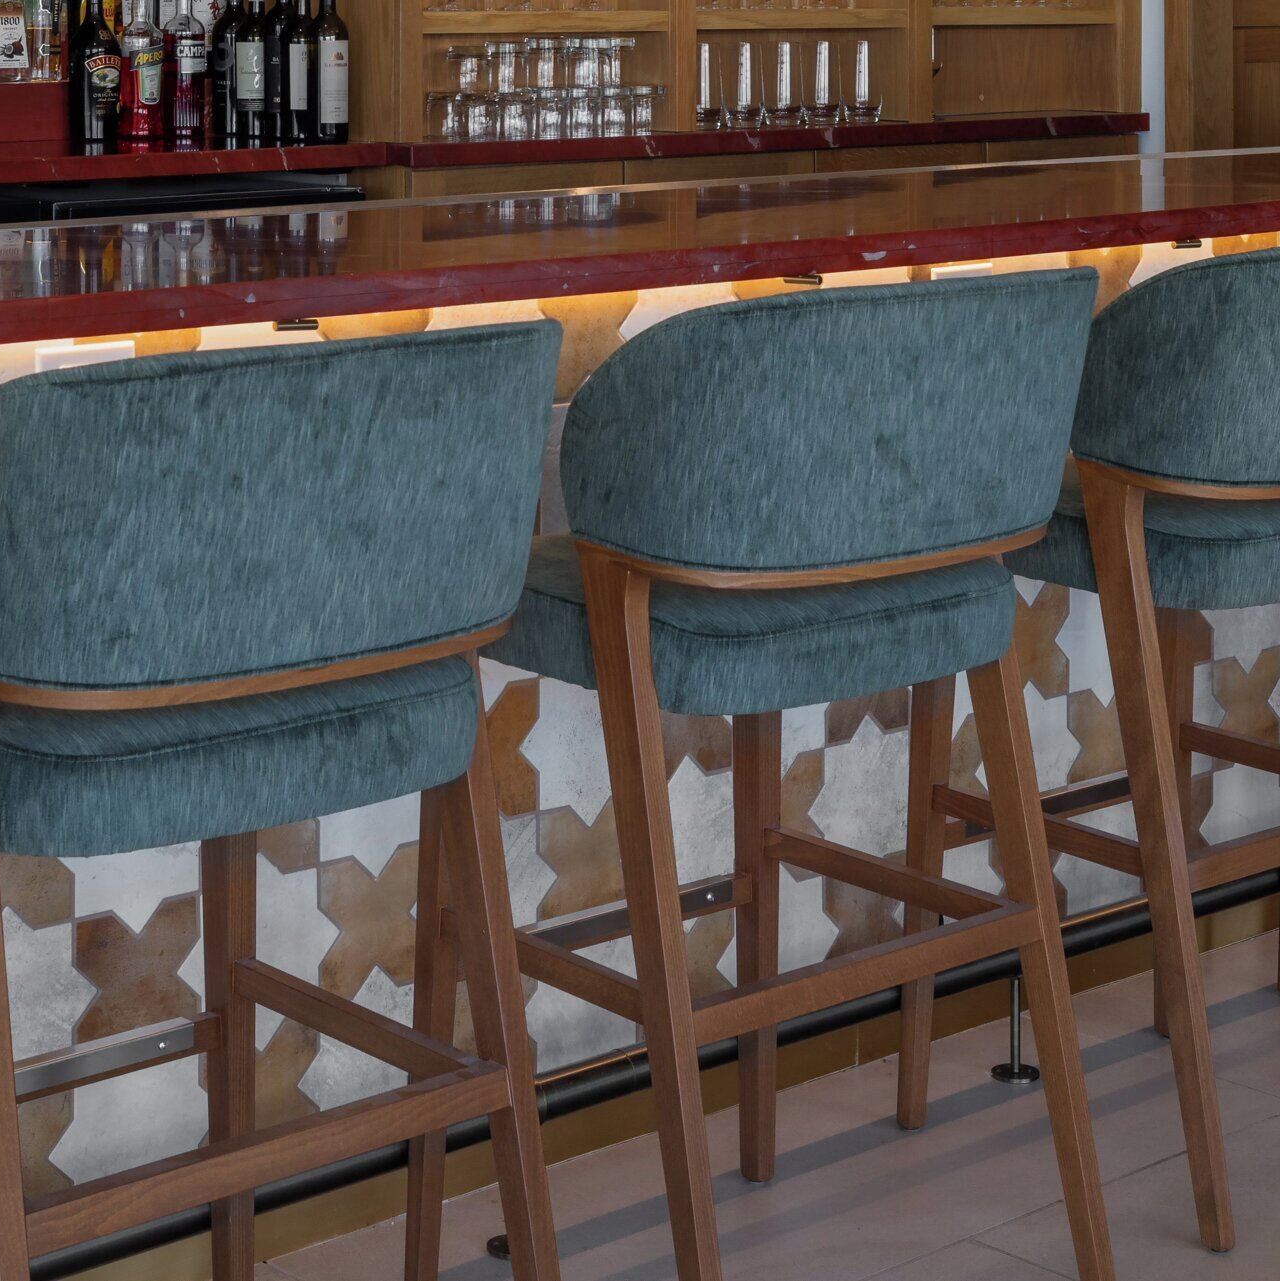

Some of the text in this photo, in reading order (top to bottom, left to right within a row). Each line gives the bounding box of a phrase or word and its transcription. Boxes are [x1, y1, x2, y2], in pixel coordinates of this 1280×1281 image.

[0, 16, 21, 25] 1800
[135, 48, 164, 66] APERO
[176, 45, 205, 58] CAMPA
